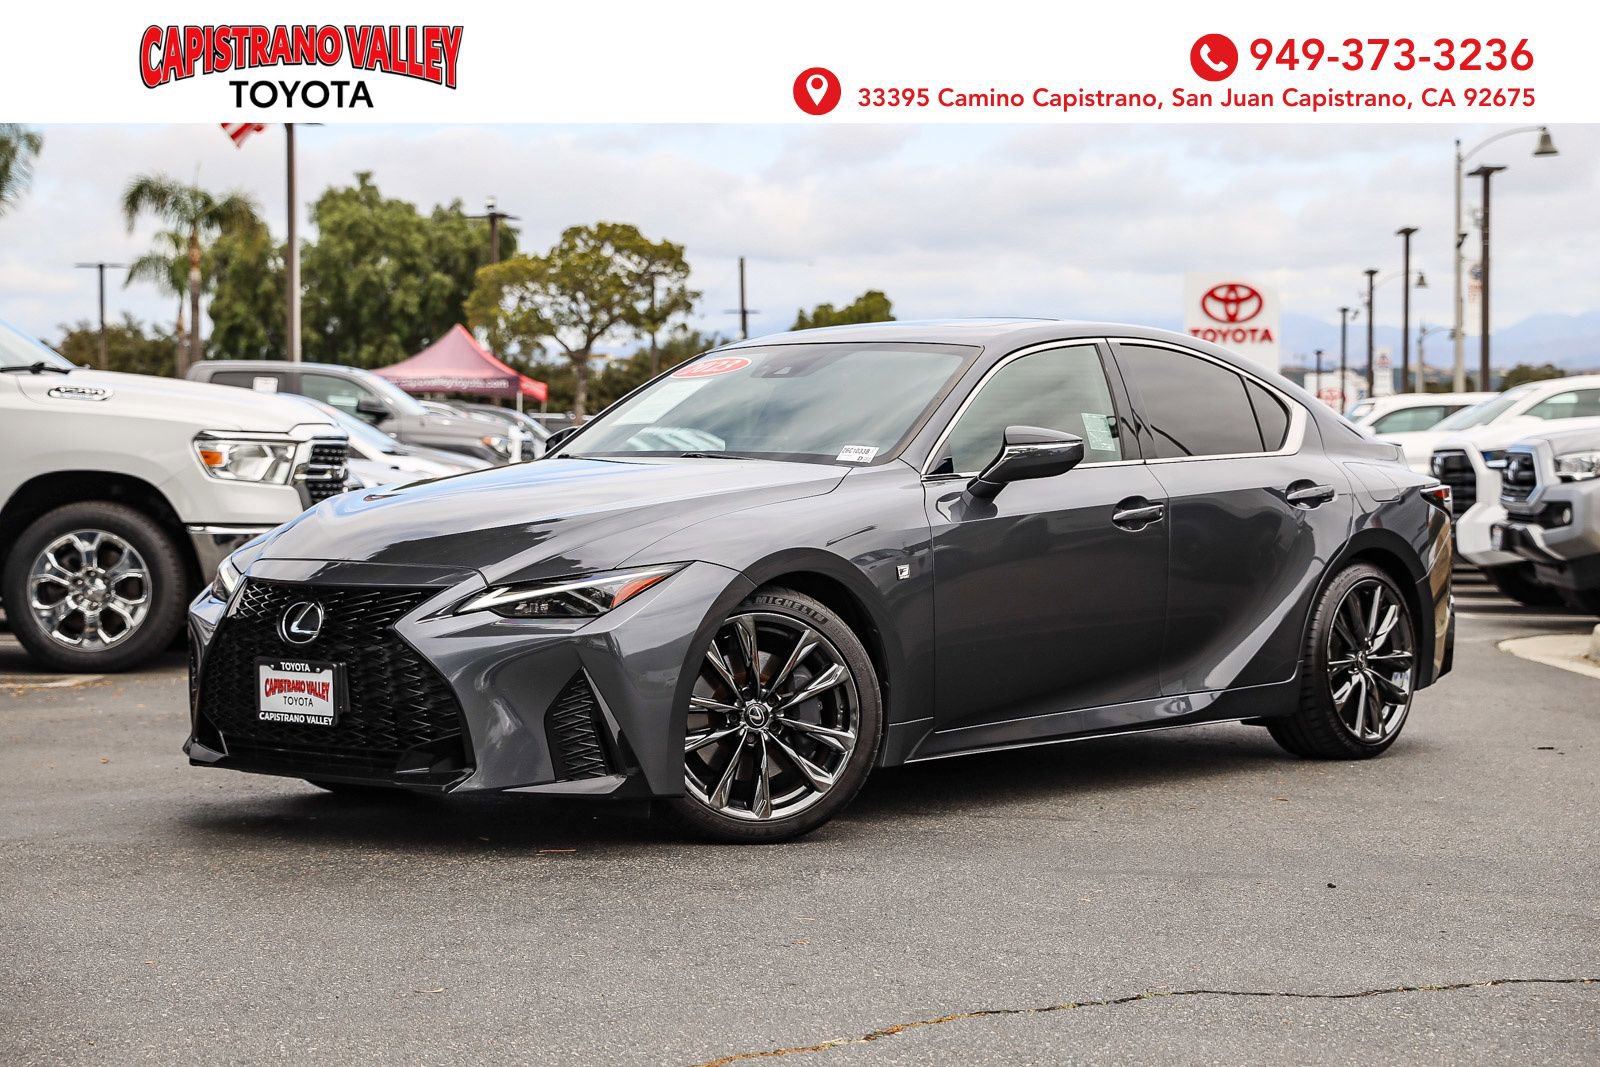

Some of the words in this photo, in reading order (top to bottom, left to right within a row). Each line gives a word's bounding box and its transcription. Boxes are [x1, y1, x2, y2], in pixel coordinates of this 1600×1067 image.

[1190, 328, 1273, 343] TOYOTA
[755, 596, 828, 624] MICHELIN
[280, 661, 310, 672] TOYOTA
[265, 678, 306, 697] CAPISTRANO
[306, 681, 330, 702] VALLEY
[283, 696, 313, 707] TOYOTA
[259, 711, 305, 724] CAPISTRANO
[306, 716, 333, 726] VALLEY
